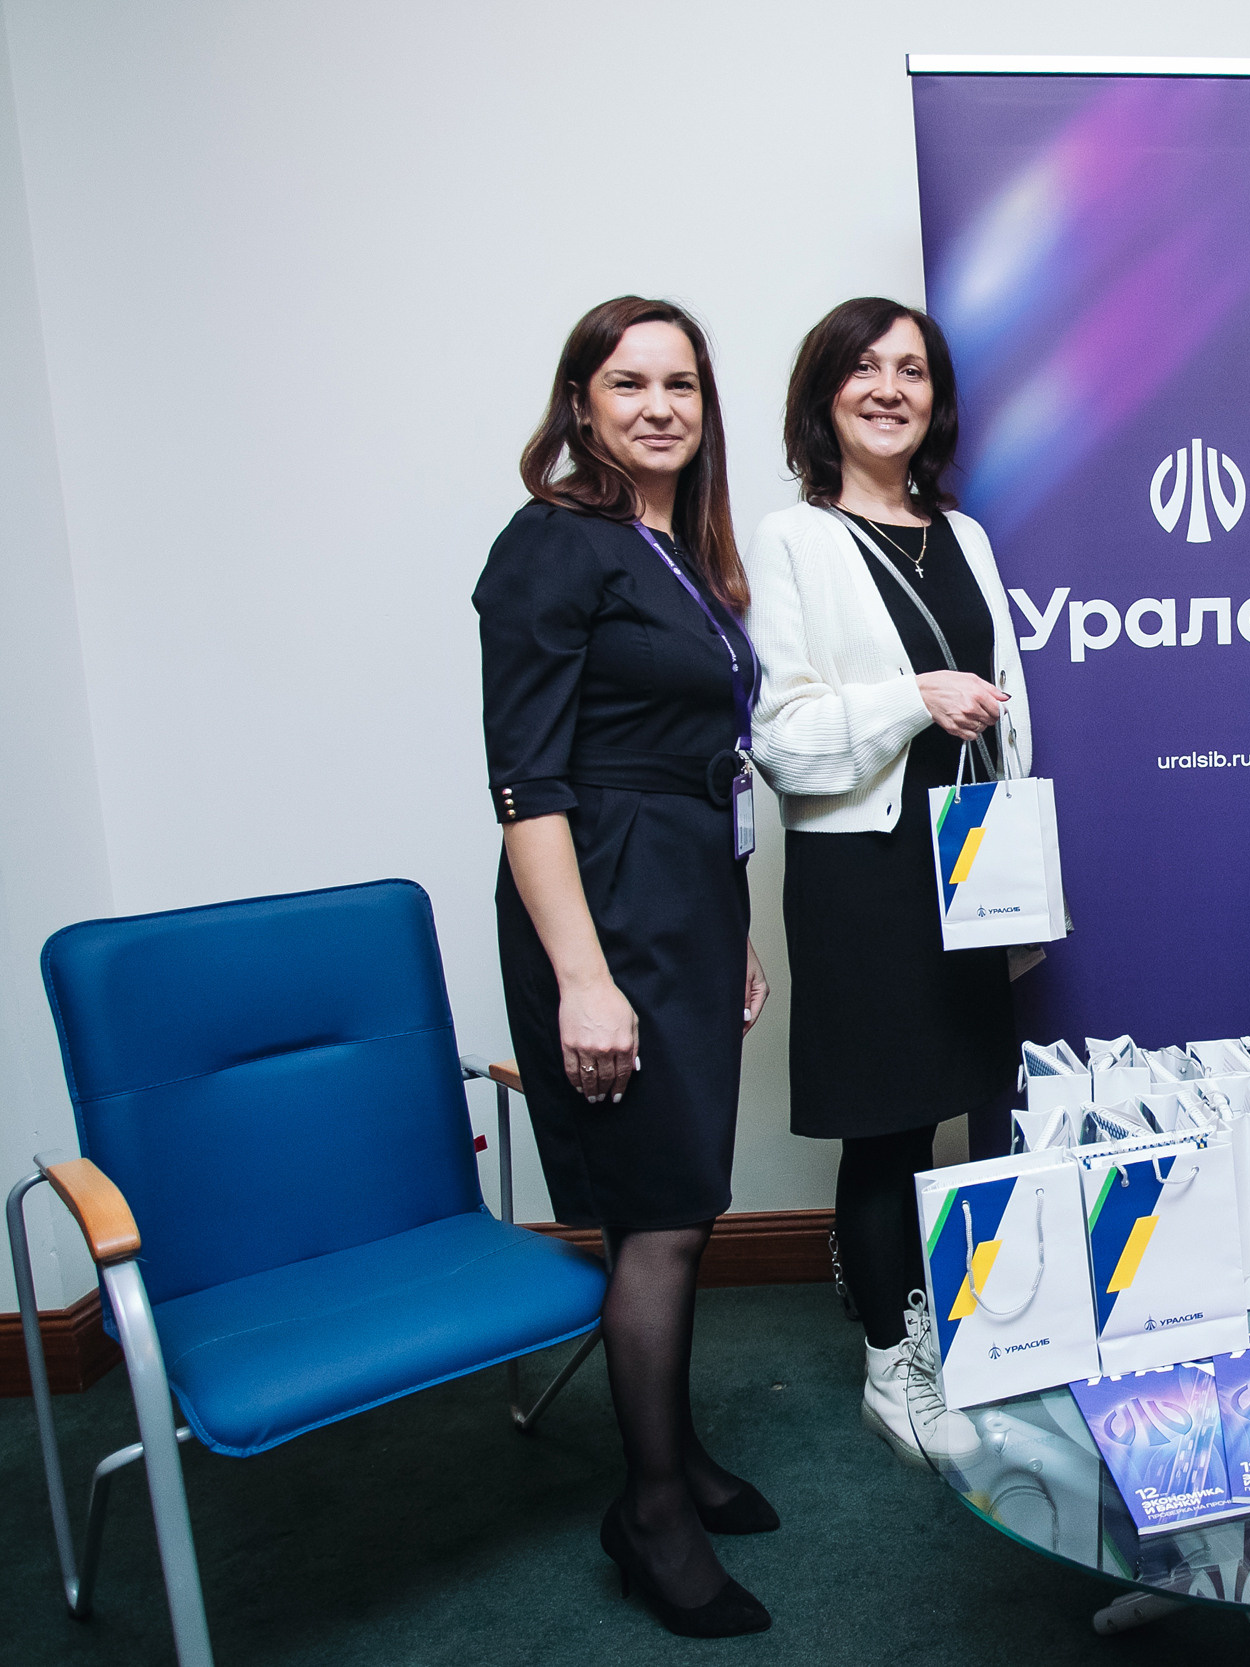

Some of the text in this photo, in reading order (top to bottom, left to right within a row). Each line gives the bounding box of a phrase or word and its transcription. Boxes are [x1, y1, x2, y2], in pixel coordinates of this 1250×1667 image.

[988, 906, 1021, 915] УРАЛСИБ
[1159, 1312, 1204, 1327] УРАЛСИБ
[1004, 1337, 1050, 1354] УРАЛСИБ
[1135, 1487, 1159, 1500] 12
[1142, 1486, 1225, 1509] ЭКОНОМИКА
[1144, 1498, 1201, 1515] И БАНКИ
